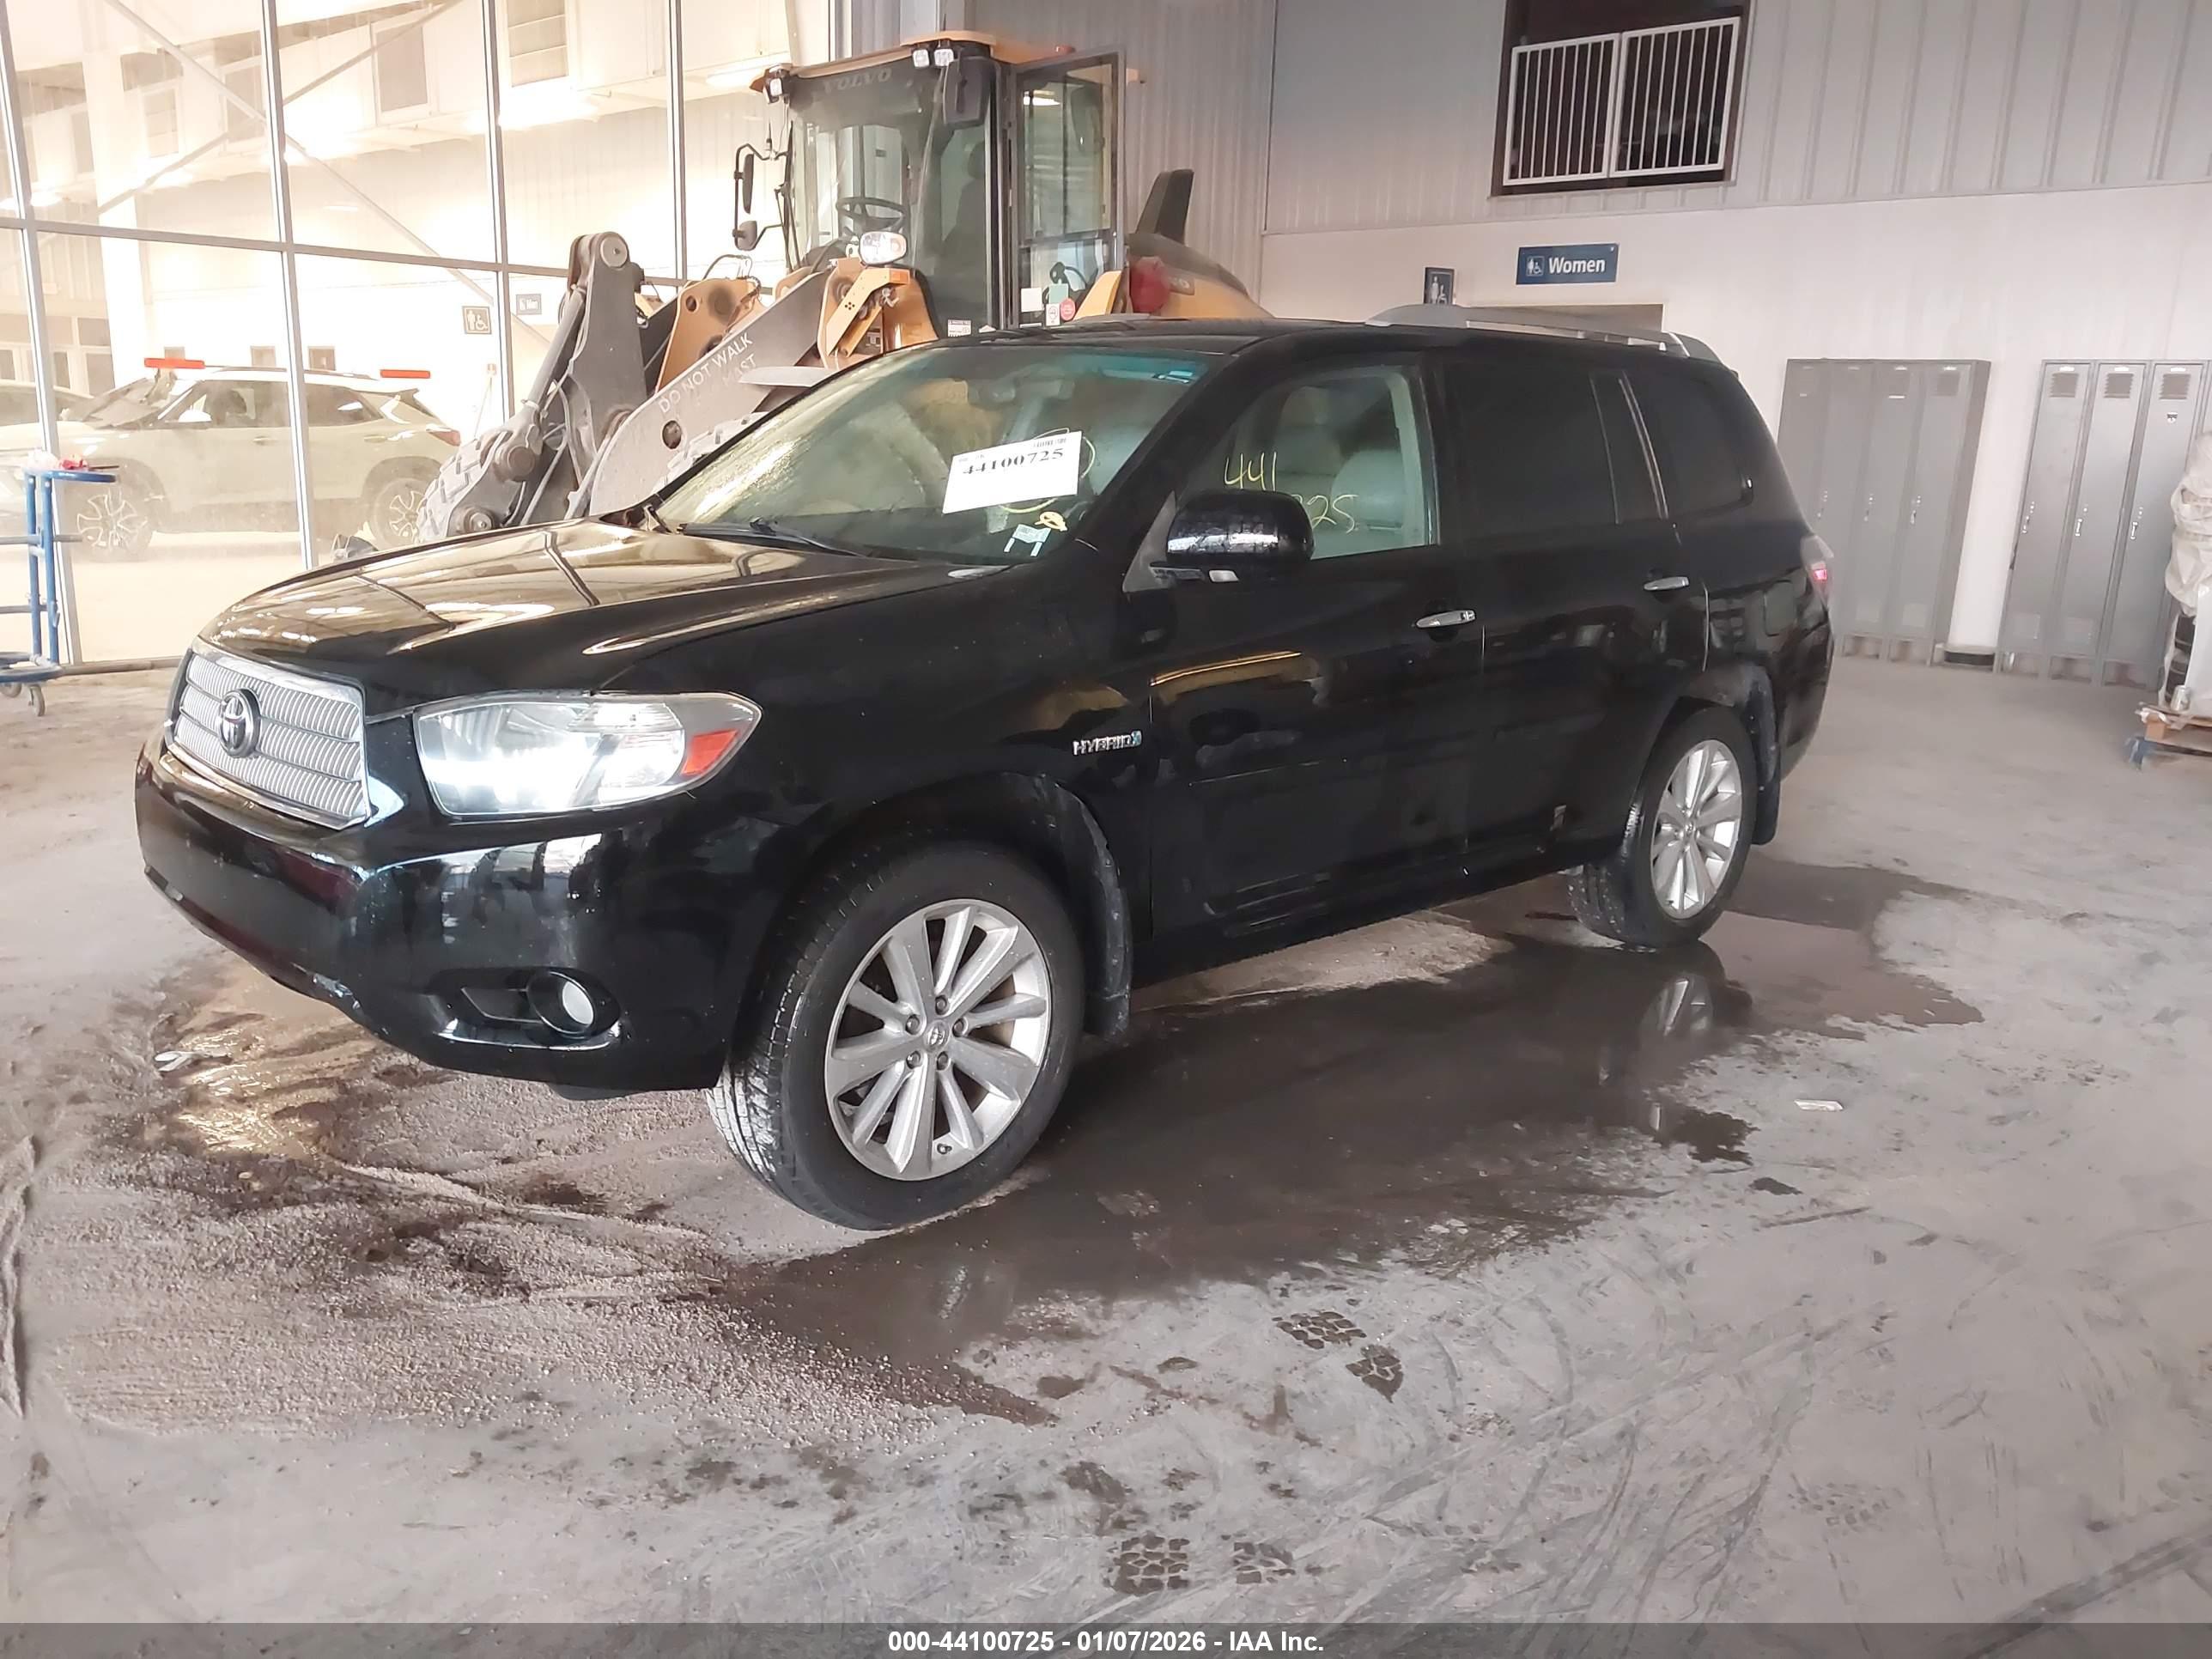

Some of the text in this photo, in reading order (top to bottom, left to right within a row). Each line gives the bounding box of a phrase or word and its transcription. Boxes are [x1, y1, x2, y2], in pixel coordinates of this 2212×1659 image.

[823, 68, 892, 94] VOLVO
[1548, 256, 1606, 274] Women
[658, 332, 753, 413] DO NOT WALK
[963, 447, 1065, 475] 44100725
[1224, 451, 1277, 491] 441
[1073, 734, 1133, 756] HYBRID
